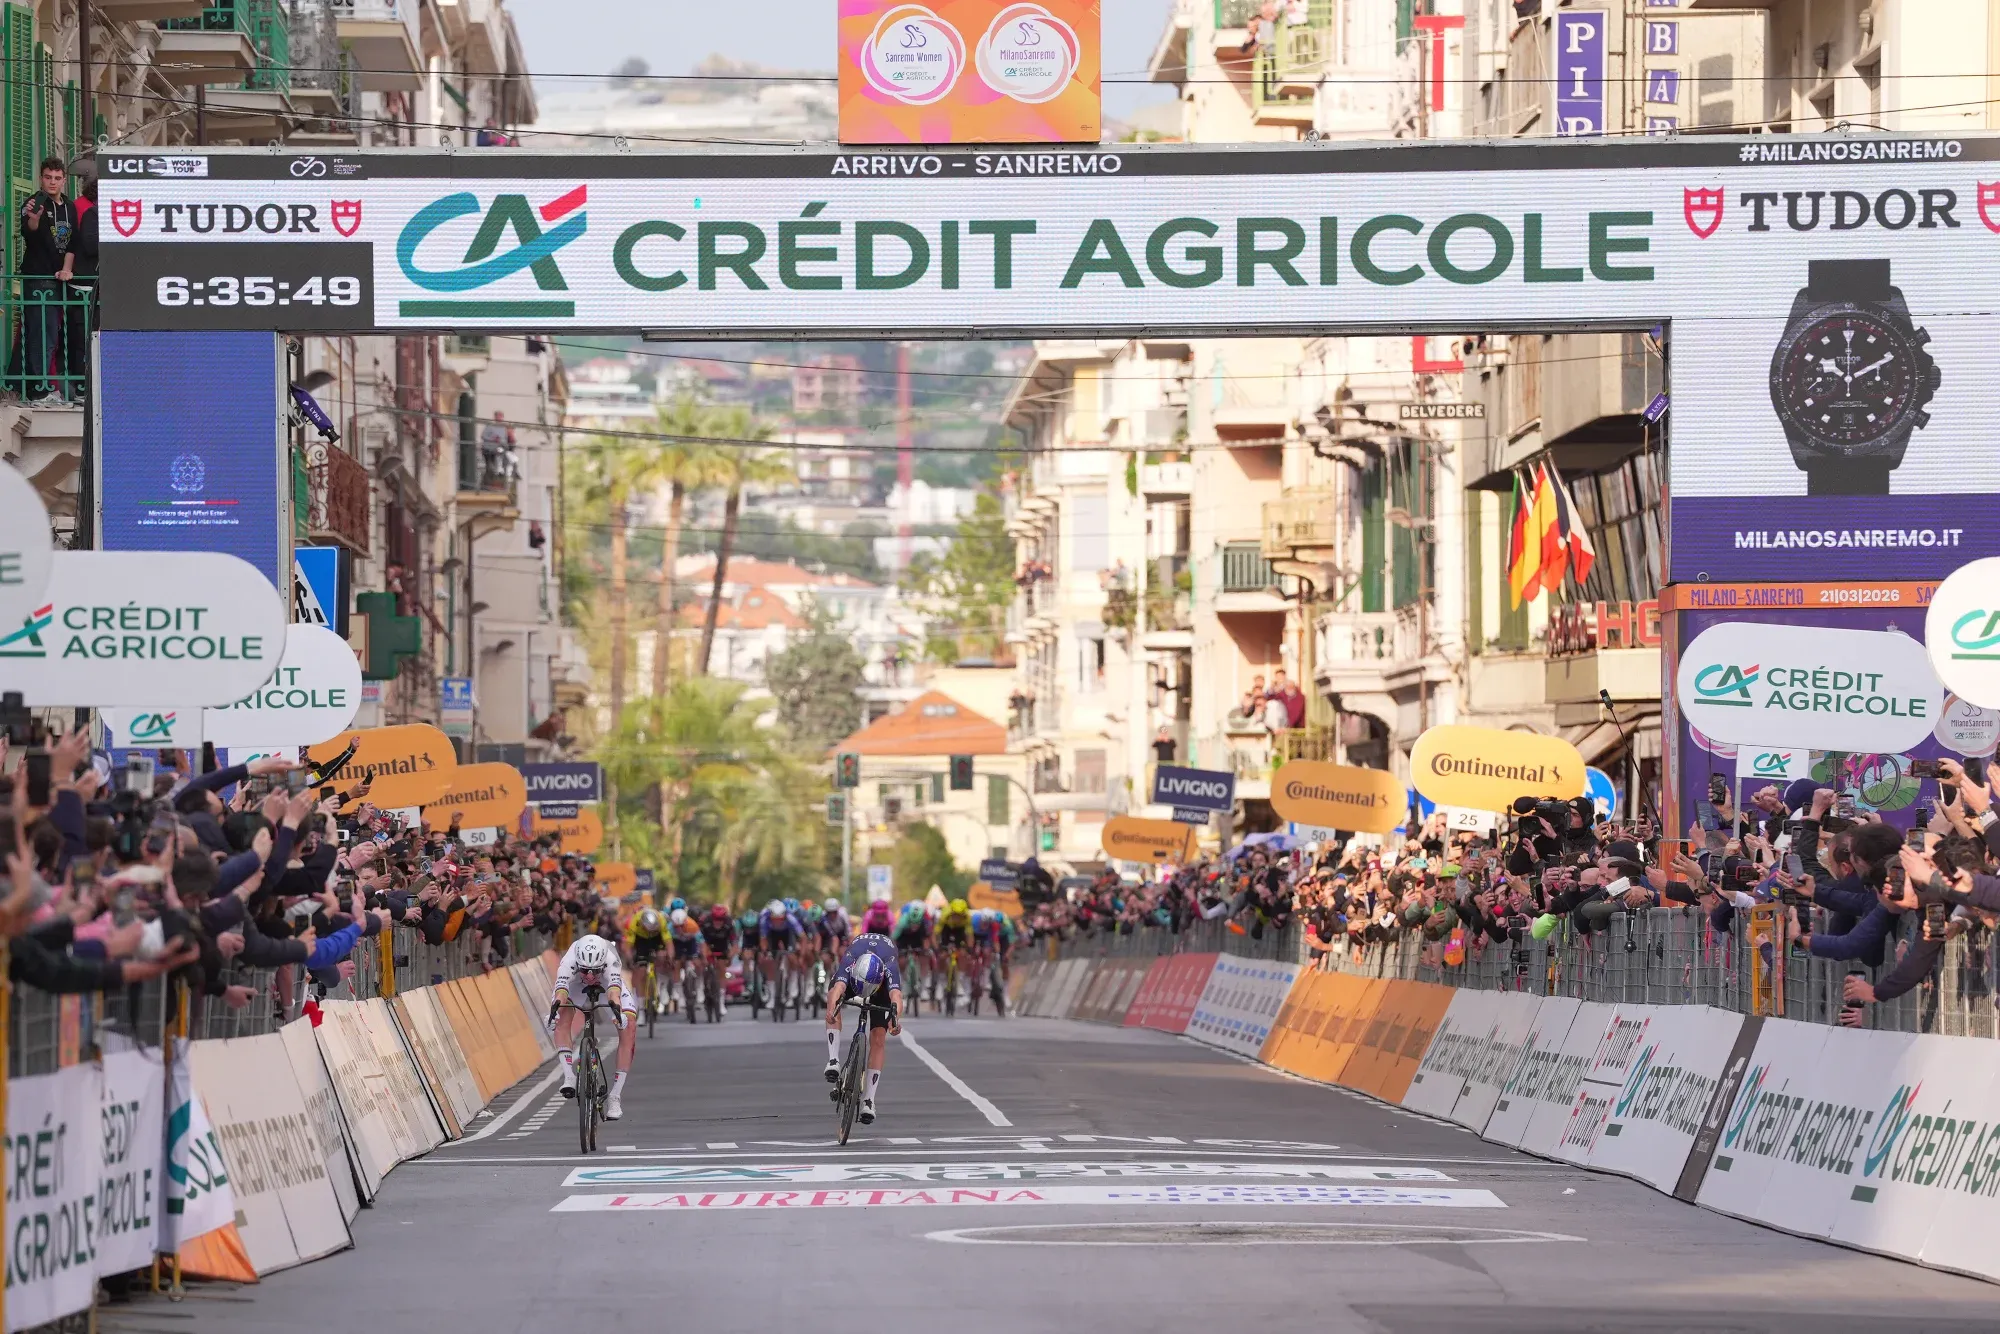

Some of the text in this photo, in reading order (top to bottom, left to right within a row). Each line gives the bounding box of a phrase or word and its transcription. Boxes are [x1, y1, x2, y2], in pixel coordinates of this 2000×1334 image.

[885, 52, 943, 62] Sanremo Women
[1000, 49, 1056, 60] MilanoSanremo
[1739, 140, 1962, 162] #MILANOSANREMO
[108, 159, 144, 173] UCI
[171, 159, 202, 167] WORLD
[831, 155, 943, 176] ARRIVO
[975, 154, 1122, 175] SANREMO
[154, 203, 320, 234] TUDOR
[1740, 188, 1961, 232] TUDOR
[613, 201, 1655, 292] CRÉDIT AGRICOLE
[156, 276, 361, 306] 6:35:49
[1400, 404, 1484, 418] BELVEDERE
[1734, 528, 1963, 549] MILANOSANREMO.IT
[62, 600, 209, 631] CRÉDIT
[62, 635, 264, 660] AGRICOLE
[1766, 665, 1883, 693] CRÉDIT
[1764, 690, 1927, 718] AGRICOLE
[1430, 753, 1545, 783] Continental
[523, 773, 593, 791] LIVIGNO
[1158, 777, 1229, 799] LIVIGNO
[1285, 780, 1376, 808] Continental
[540, 806, 578, 817] LIVIGNO
[1172, 810, 1208, 821] LIVIGNO
[1458, 813, 1478, 826] 25
[470, 831, 486, 843] 50
[1310, 830, 1327, 842] 50
[1743, 1077, 1805, 1159] CRÉDIT
[1783, 1099, 1875, 1176] AGRICOLE
[1891, 1098, 1977, 1189] CRÉDIT
[606, 1189, 1048, 1207] LAURETANA
